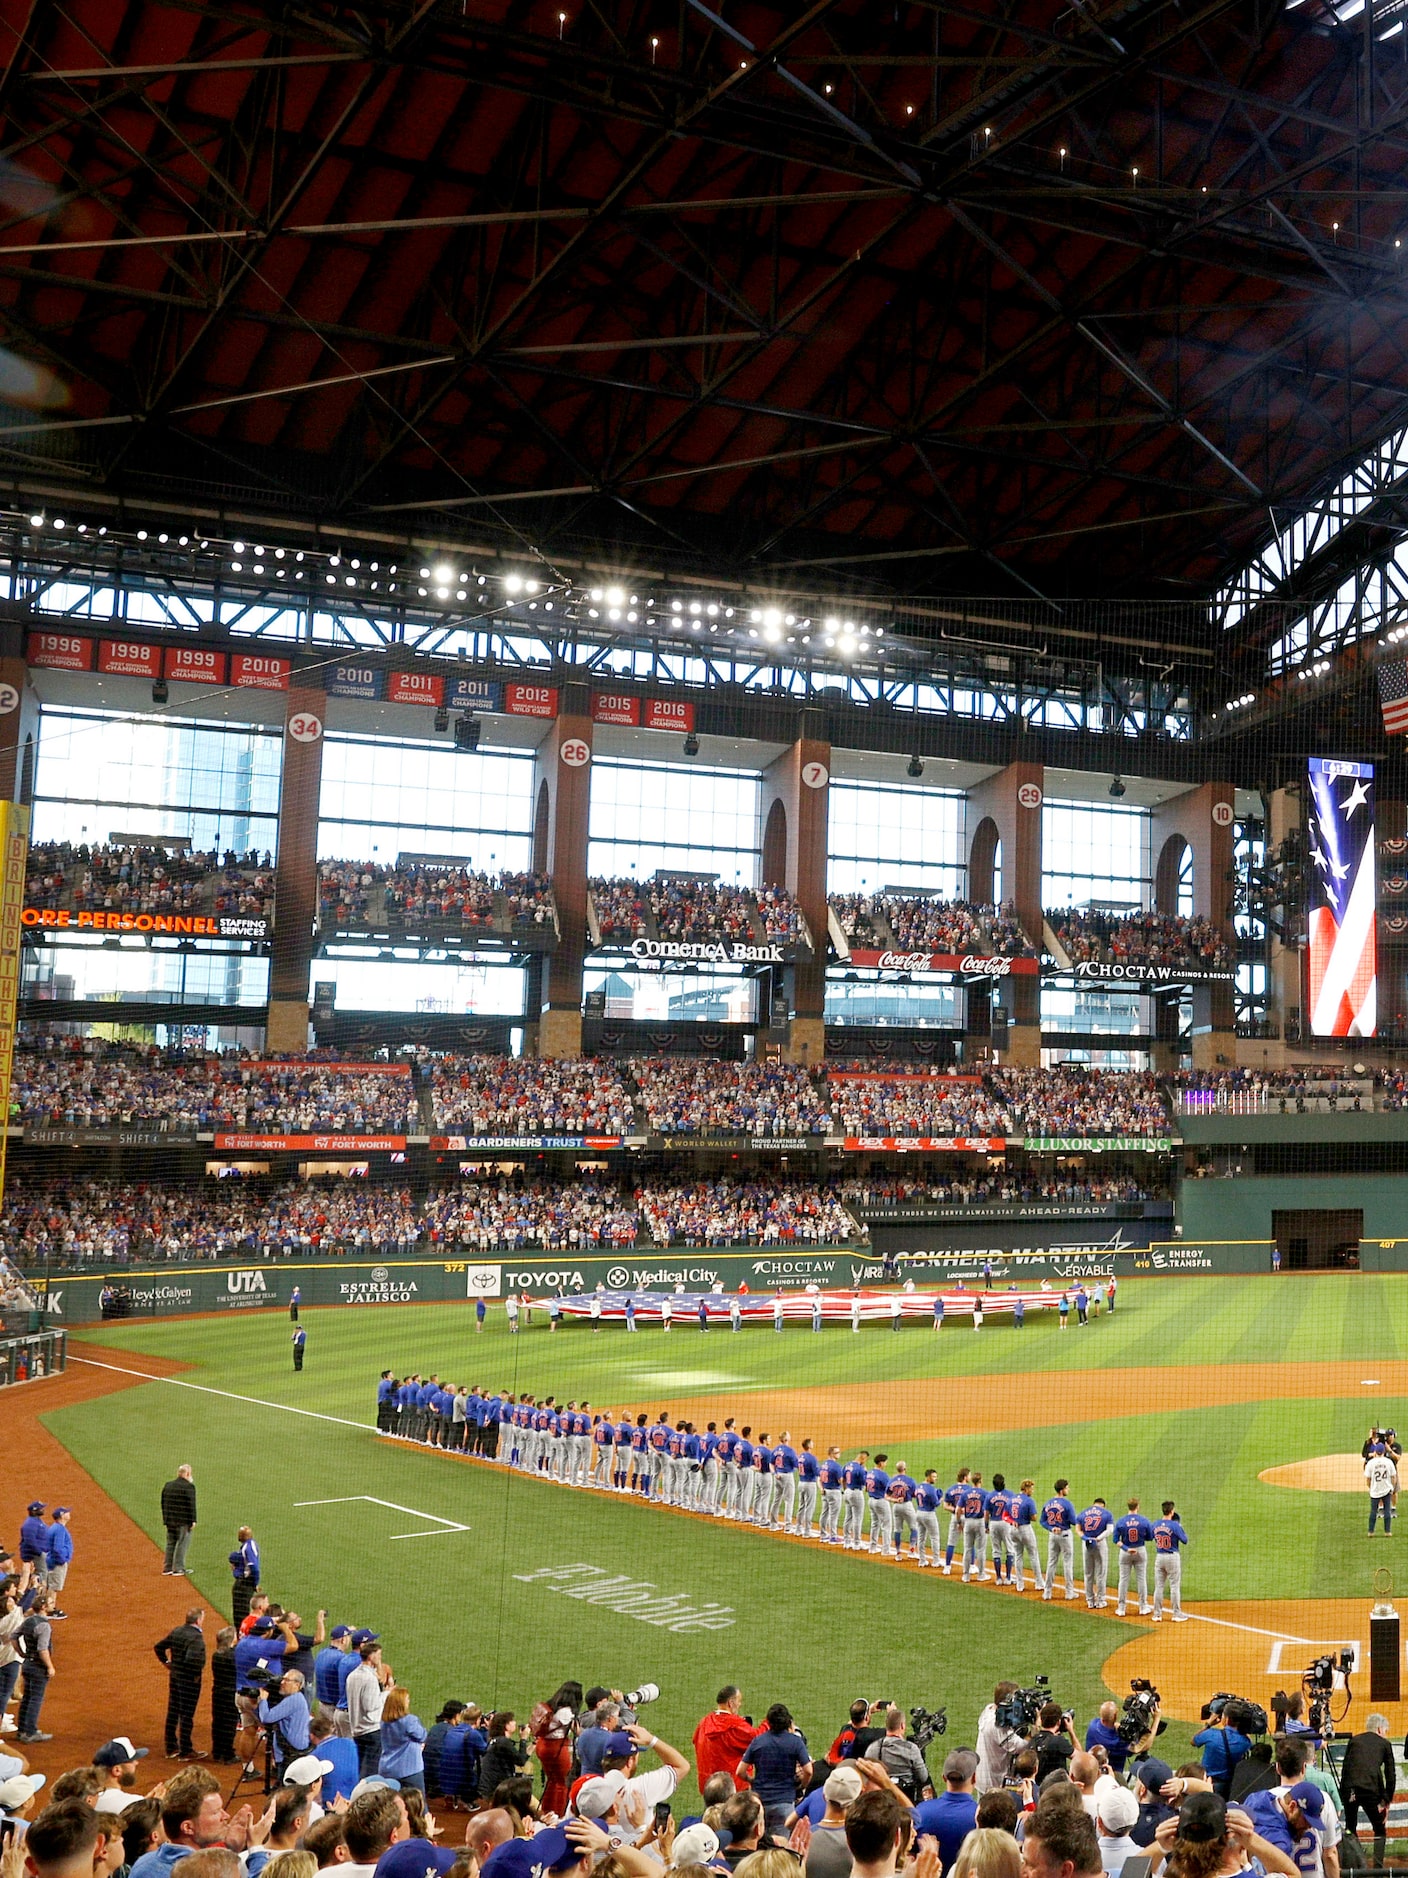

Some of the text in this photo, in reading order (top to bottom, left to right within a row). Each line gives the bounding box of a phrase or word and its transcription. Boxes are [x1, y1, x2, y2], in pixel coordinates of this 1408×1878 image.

[40, 635, 81, 653] 1996
[110, 643, 150, 660] 1998
[34, 657, 84, 668] CHAMPIONS
[176, 650, 215, 667] 1999
[105, 664, 152, 675] CHAMPIONS
[242, 657, 280, 674] 2010
[171, 671, 217, 682] CHAMPIONS
[336, 668, 373, 684] 2010
[400, 675, 432, 691] 2011
[458, 680, 489, 696] 2011
[332, 687, 375, 698] CHAMPIONS
[394, 694, 436, 704] CHAMPIONS
[516, 687, 549, 702] 2012
[452, 700, 493, 710] CHAMPIONS
[599, 696, 632, 711] 2015
[653, 702, 686, 717] 2016
[594, 715, 633, 724] CHAMPIONS
[650, 720, 688, 729] CHAMPIONS
[292, 719, 318, 736] 34
[564, 744, 586, 761] 26
[809, 767, 821, 784] 7
[1021, 787, 1039, 804] 29
[1215, 806, 1230, 822] 10
[78, 911, 219, 934] PERSONNEL
[219, 918, 266, 928] STAFFING
[220, 926, 265, 936] SERVICES
[732, 942, 784, 962] Bank
[878, 951, 931, 971] Coca-Cola
[959, 955, 1014, 975] Coca-Cola
[1086, 963, 1171, 980] CHOCTAW
[1172, 970, 1202, 979] CASINOS
[31, 1132, 65, 1142] SHIFT
[120, 1135, 149, 1144] SHIFT
[468, 1137, 542, 1148] GARDENERS
[545, 1138, 582, 1148] TRUST
[858, 1138, 883, 1146] DEX
[894, 1138, 919, 1146] DEX
[929, 1138, 954, 1146] DEX
[964, 1138, 990, 1146] DEX
[237, 1140, 286, 1149] FORT WORTH
[332, 1140, 392, 1149] FORT WORTH
[675, 1140, 738, 1148] WORLD WALLET
[1040, 1138, 1168, 1151] LUXOR STAFFING
[1020, 1207, 1060, 1215] AHEAD
[1379, 1241, 1395, 1249] 407
[1169, 1250, 1203, 1259] ENERGY
[445, 1264, 465, 1273] 372
[762, 1261, 835, 1274] CHOCTAW
[1135, 1260, 1150, 1268] 410
[1169, 1259, 1212, 1268] TRANSFER
[506, 1271, 585, 1288] TOYOTA
[632, 1269, 717, 1285] Medical City
[947, 1271, 978, 1279] LOCKHEED
[227, 1270, 266, 1294] UTA
[340, 1281, 418, 1294] ESTRELLA
[346, 1292, 411, 1304] JALISCO
[1374, 1470, 1388, 1482] 24
[1047, 1511, 1062, 1526] 24
[1084, 1515, 1102, 1531] 27
[1128, 1528, 1138, 1542] 8
[1155, 1534, 1171, 1549] 30
